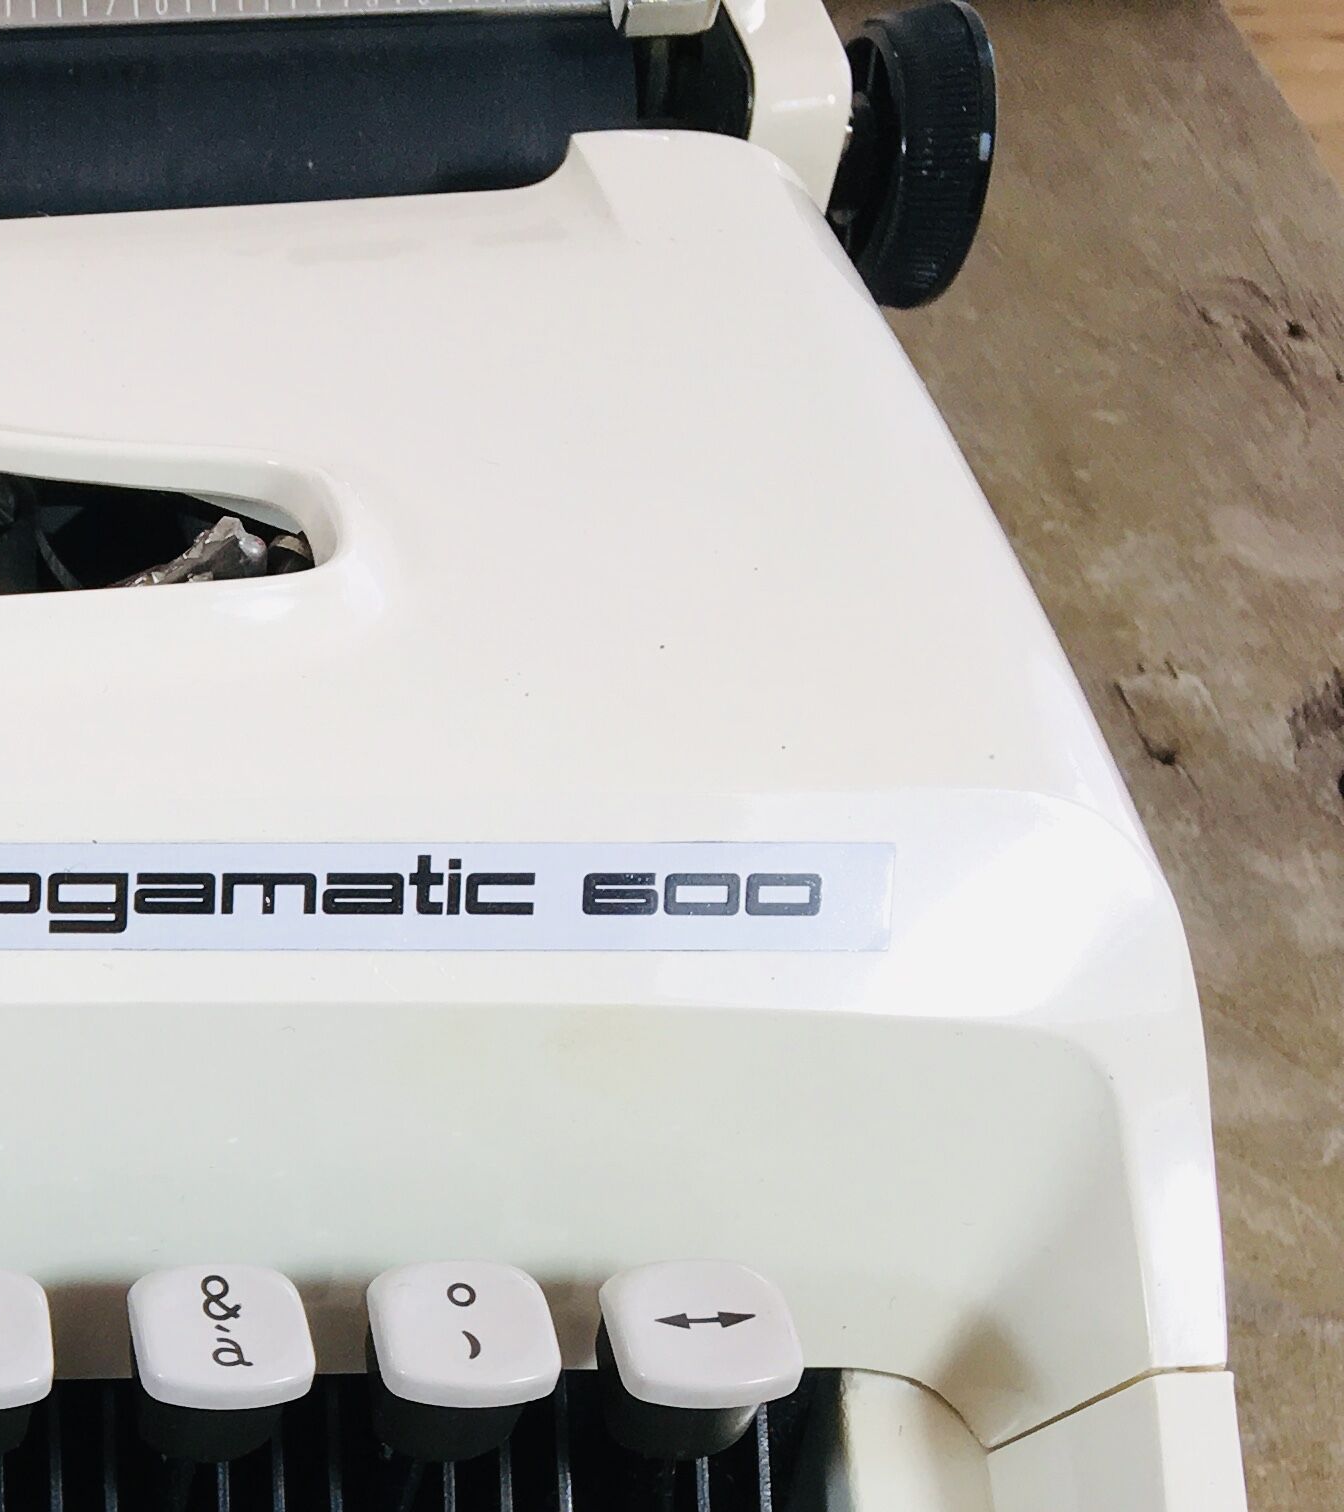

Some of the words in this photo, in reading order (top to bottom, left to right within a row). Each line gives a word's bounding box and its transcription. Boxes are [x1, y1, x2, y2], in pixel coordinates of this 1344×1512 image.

[581, 871, 821, 917] 600
[199, 1273, 243, 1322] &
[210, 1323, 255, 1368] à
